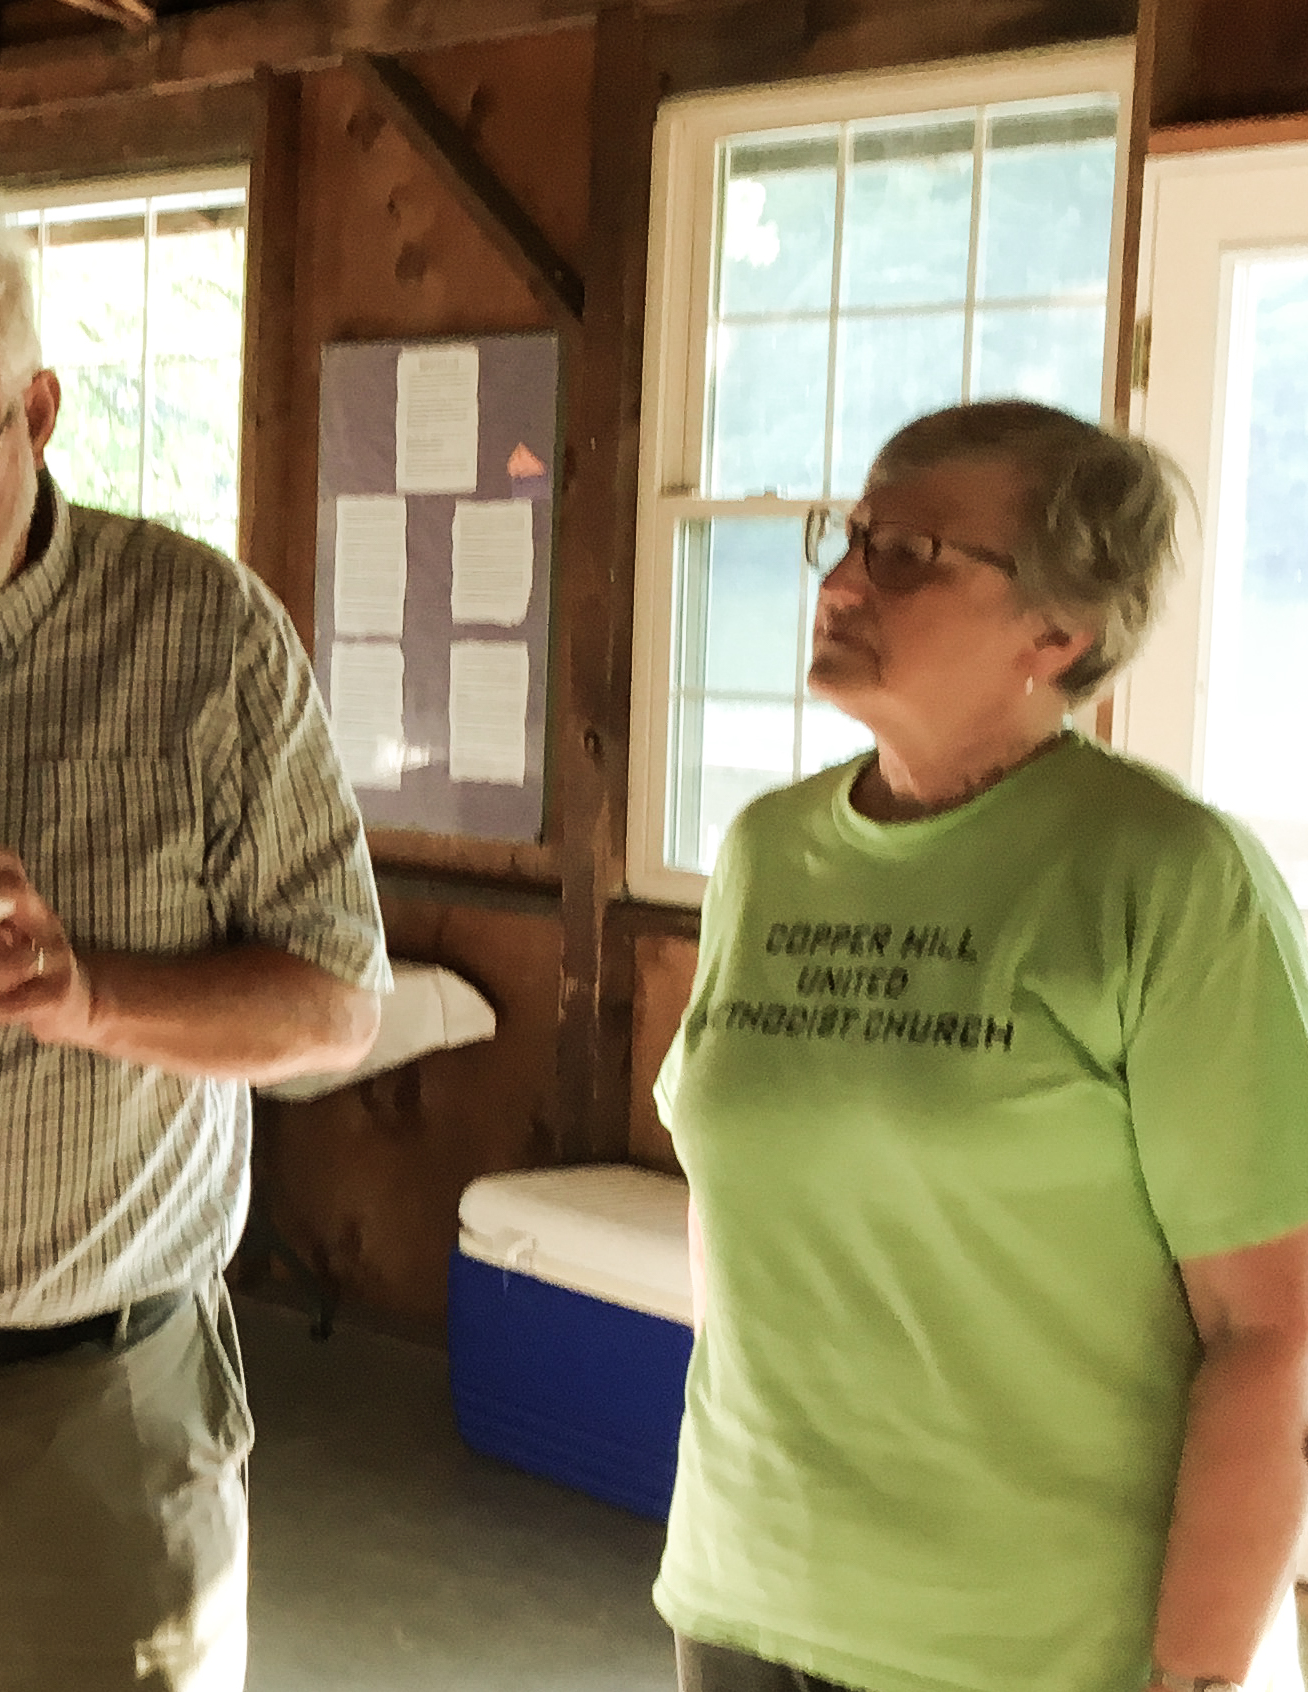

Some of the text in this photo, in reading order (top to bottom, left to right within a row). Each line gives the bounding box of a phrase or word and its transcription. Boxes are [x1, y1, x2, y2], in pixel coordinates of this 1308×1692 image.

[766, 922, 978, 962] COPPER HILL
[796, 965, 909, 1000] UNITED
[863, 1008, 1014, 1053] CHURCH
